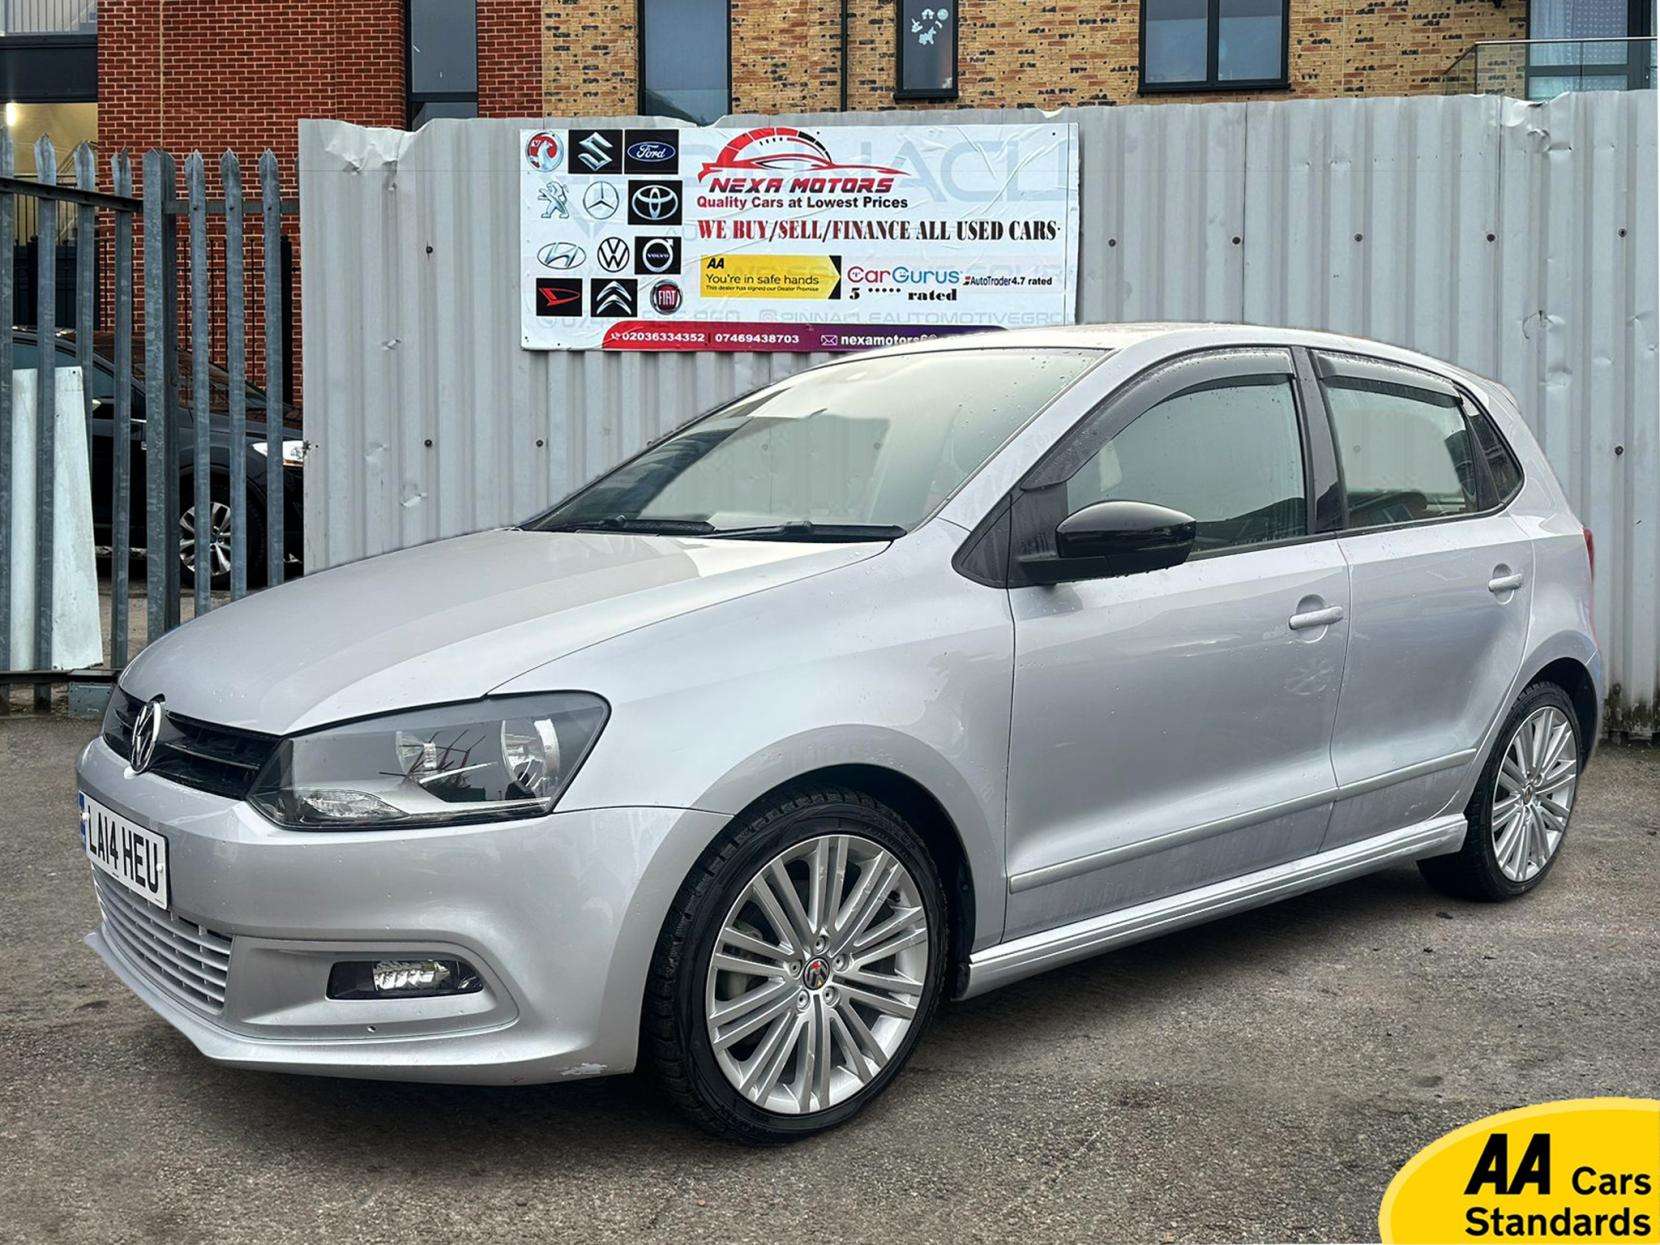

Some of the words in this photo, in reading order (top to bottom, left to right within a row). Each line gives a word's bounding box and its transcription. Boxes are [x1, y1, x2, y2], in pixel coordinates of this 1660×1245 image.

[636, 144, 666, 159] Ford
[709, 178, 782, 193] NEXA
[789, 178, 895, 193] MOTORS
[697, 196, 746, 211] Quality
[752, 196, 784, 208] Cars
[788, 196, 803, 208] at
[807, 196, 859, 208] Lowest
[863, 196, 909, 208] Prices
[697, 219, 726, 240] WE
[732, 219, 910, 243] BUY/SELL/FINANCE
[916, 219, 951, 241] ALL
[956, 219, 1004, 241] USED
[1008, 219, 1058, 241] CARS
[706, 257, 725, 270] AA
[706, 273, 741, 285] You're
[744, 273, 754, 284] in
[757, 273, 781, 285] safe
[783, 274, 819, 285] hands
[847, 265, 960, 284] CarGurus
[1027, 276, 1053, 286] rated
[658, 289, 677, 306] FIAT
[849, 287, 861, 301] 5
[908, 288, 957, 301] rated
[622, 332, 705, 343] 02036334352
[714, 333, 800, 344] 07469438703
[88, 804, 119, 870] LA14
[121, 826, 159, 894] HEU
